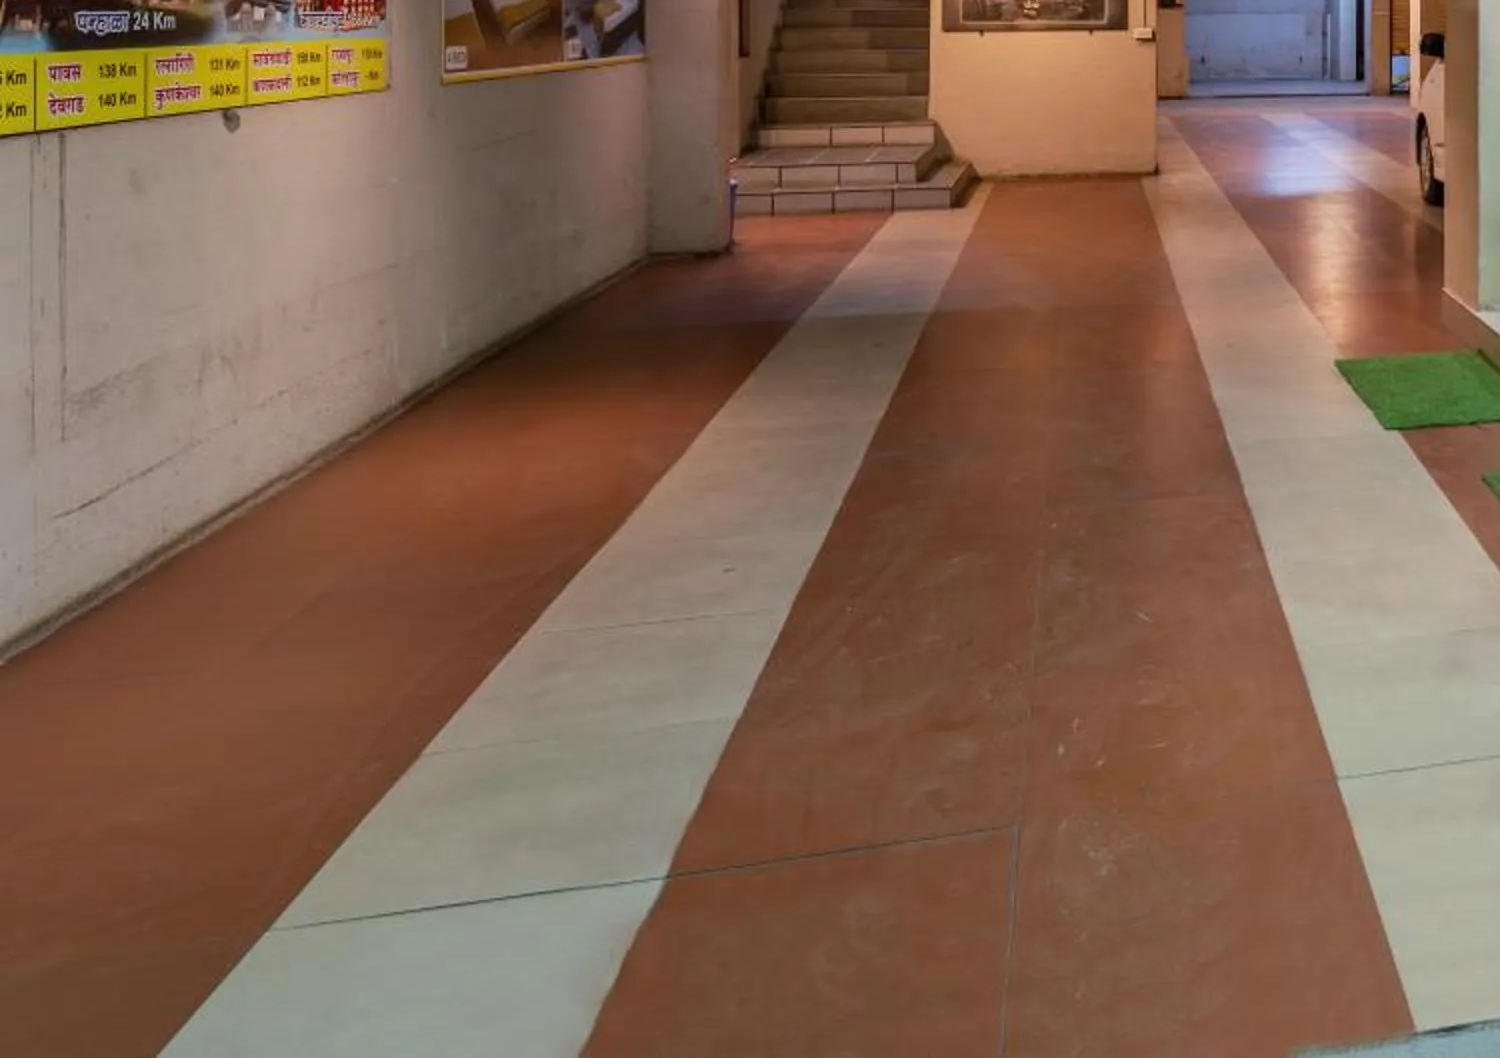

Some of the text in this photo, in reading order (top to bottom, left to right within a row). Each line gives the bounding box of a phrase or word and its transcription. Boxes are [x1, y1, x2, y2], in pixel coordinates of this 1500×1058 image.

[133, 11, 150, 32] 24
[153, 11, 177, 31] Km
[5, 69, 27, 86] Km
[119, 61, 137, 78] Km
[119, 90, 137, 105] Km
[5, 100, 27, 119] Km
